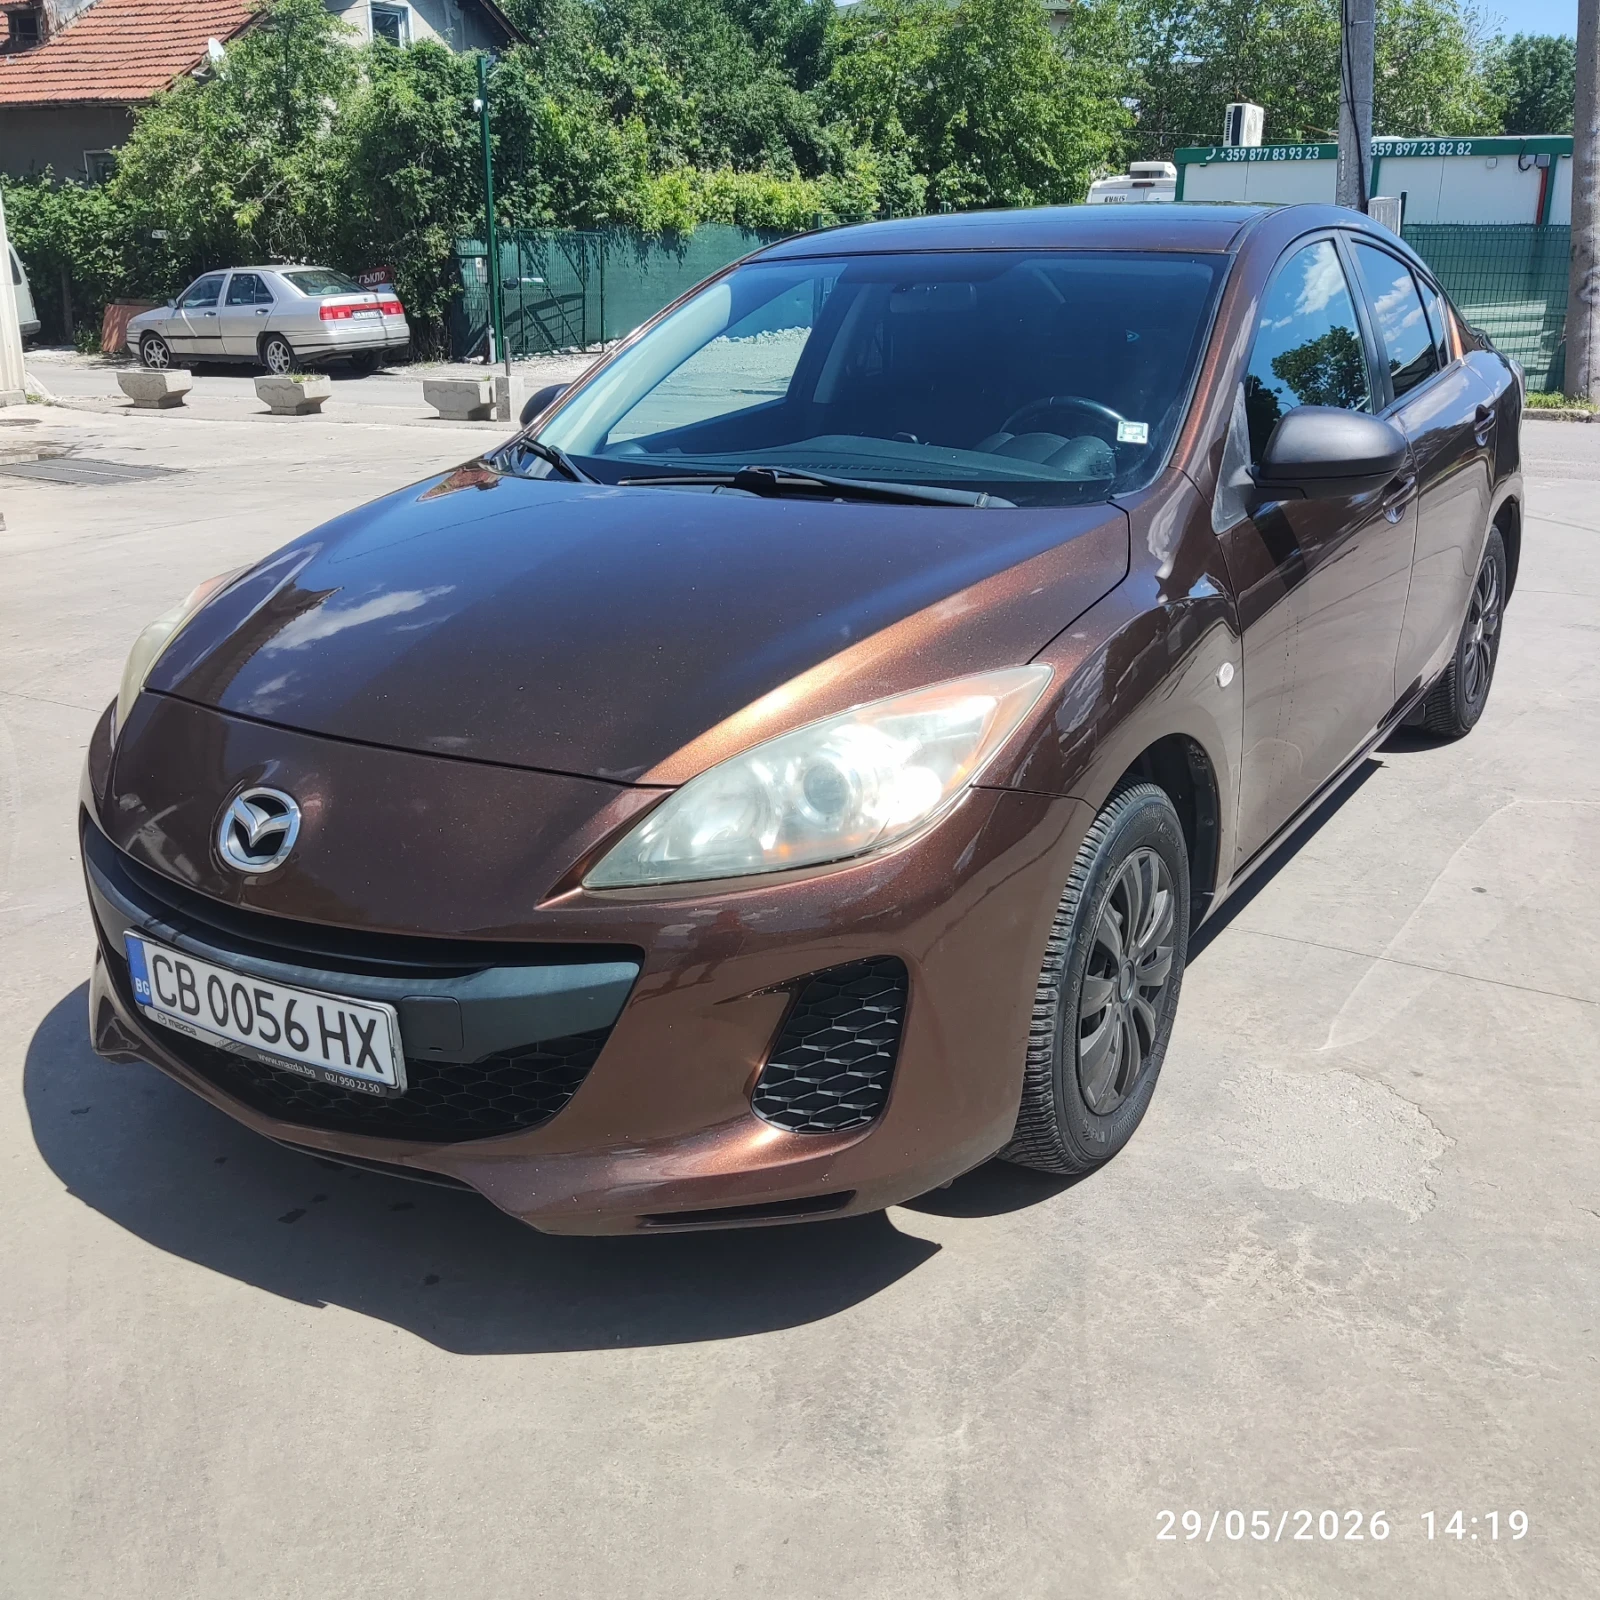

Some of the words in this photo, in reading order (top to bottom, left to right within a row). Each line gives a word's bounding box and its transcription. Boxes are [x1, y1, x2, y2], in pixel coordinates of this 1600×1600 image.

[1220, 148, 1246, 161] +359
[1249, 148, 1269, 161] 877
[1272, 147, 1286, 160] 83
[1289, 147, 1302, 160] 93
[1305, 146, 1320, 159] 23
[1371, 143, 1392, 156] 359
[1395, 143, 1417, 155] 897
[1420, 142, 1435, 155] 23
[1439, 142, 1453, 155] 82
[1457, 142, 1472, 155] 82
[135, 977, 150, 996] BG
[257, 1053, 316, 1078] www.mazda.bg
[340, 1076, 355, 1088] 950
[357, 1081, 368, 1091] 22
[369, 1084, 380, 1093] 50
